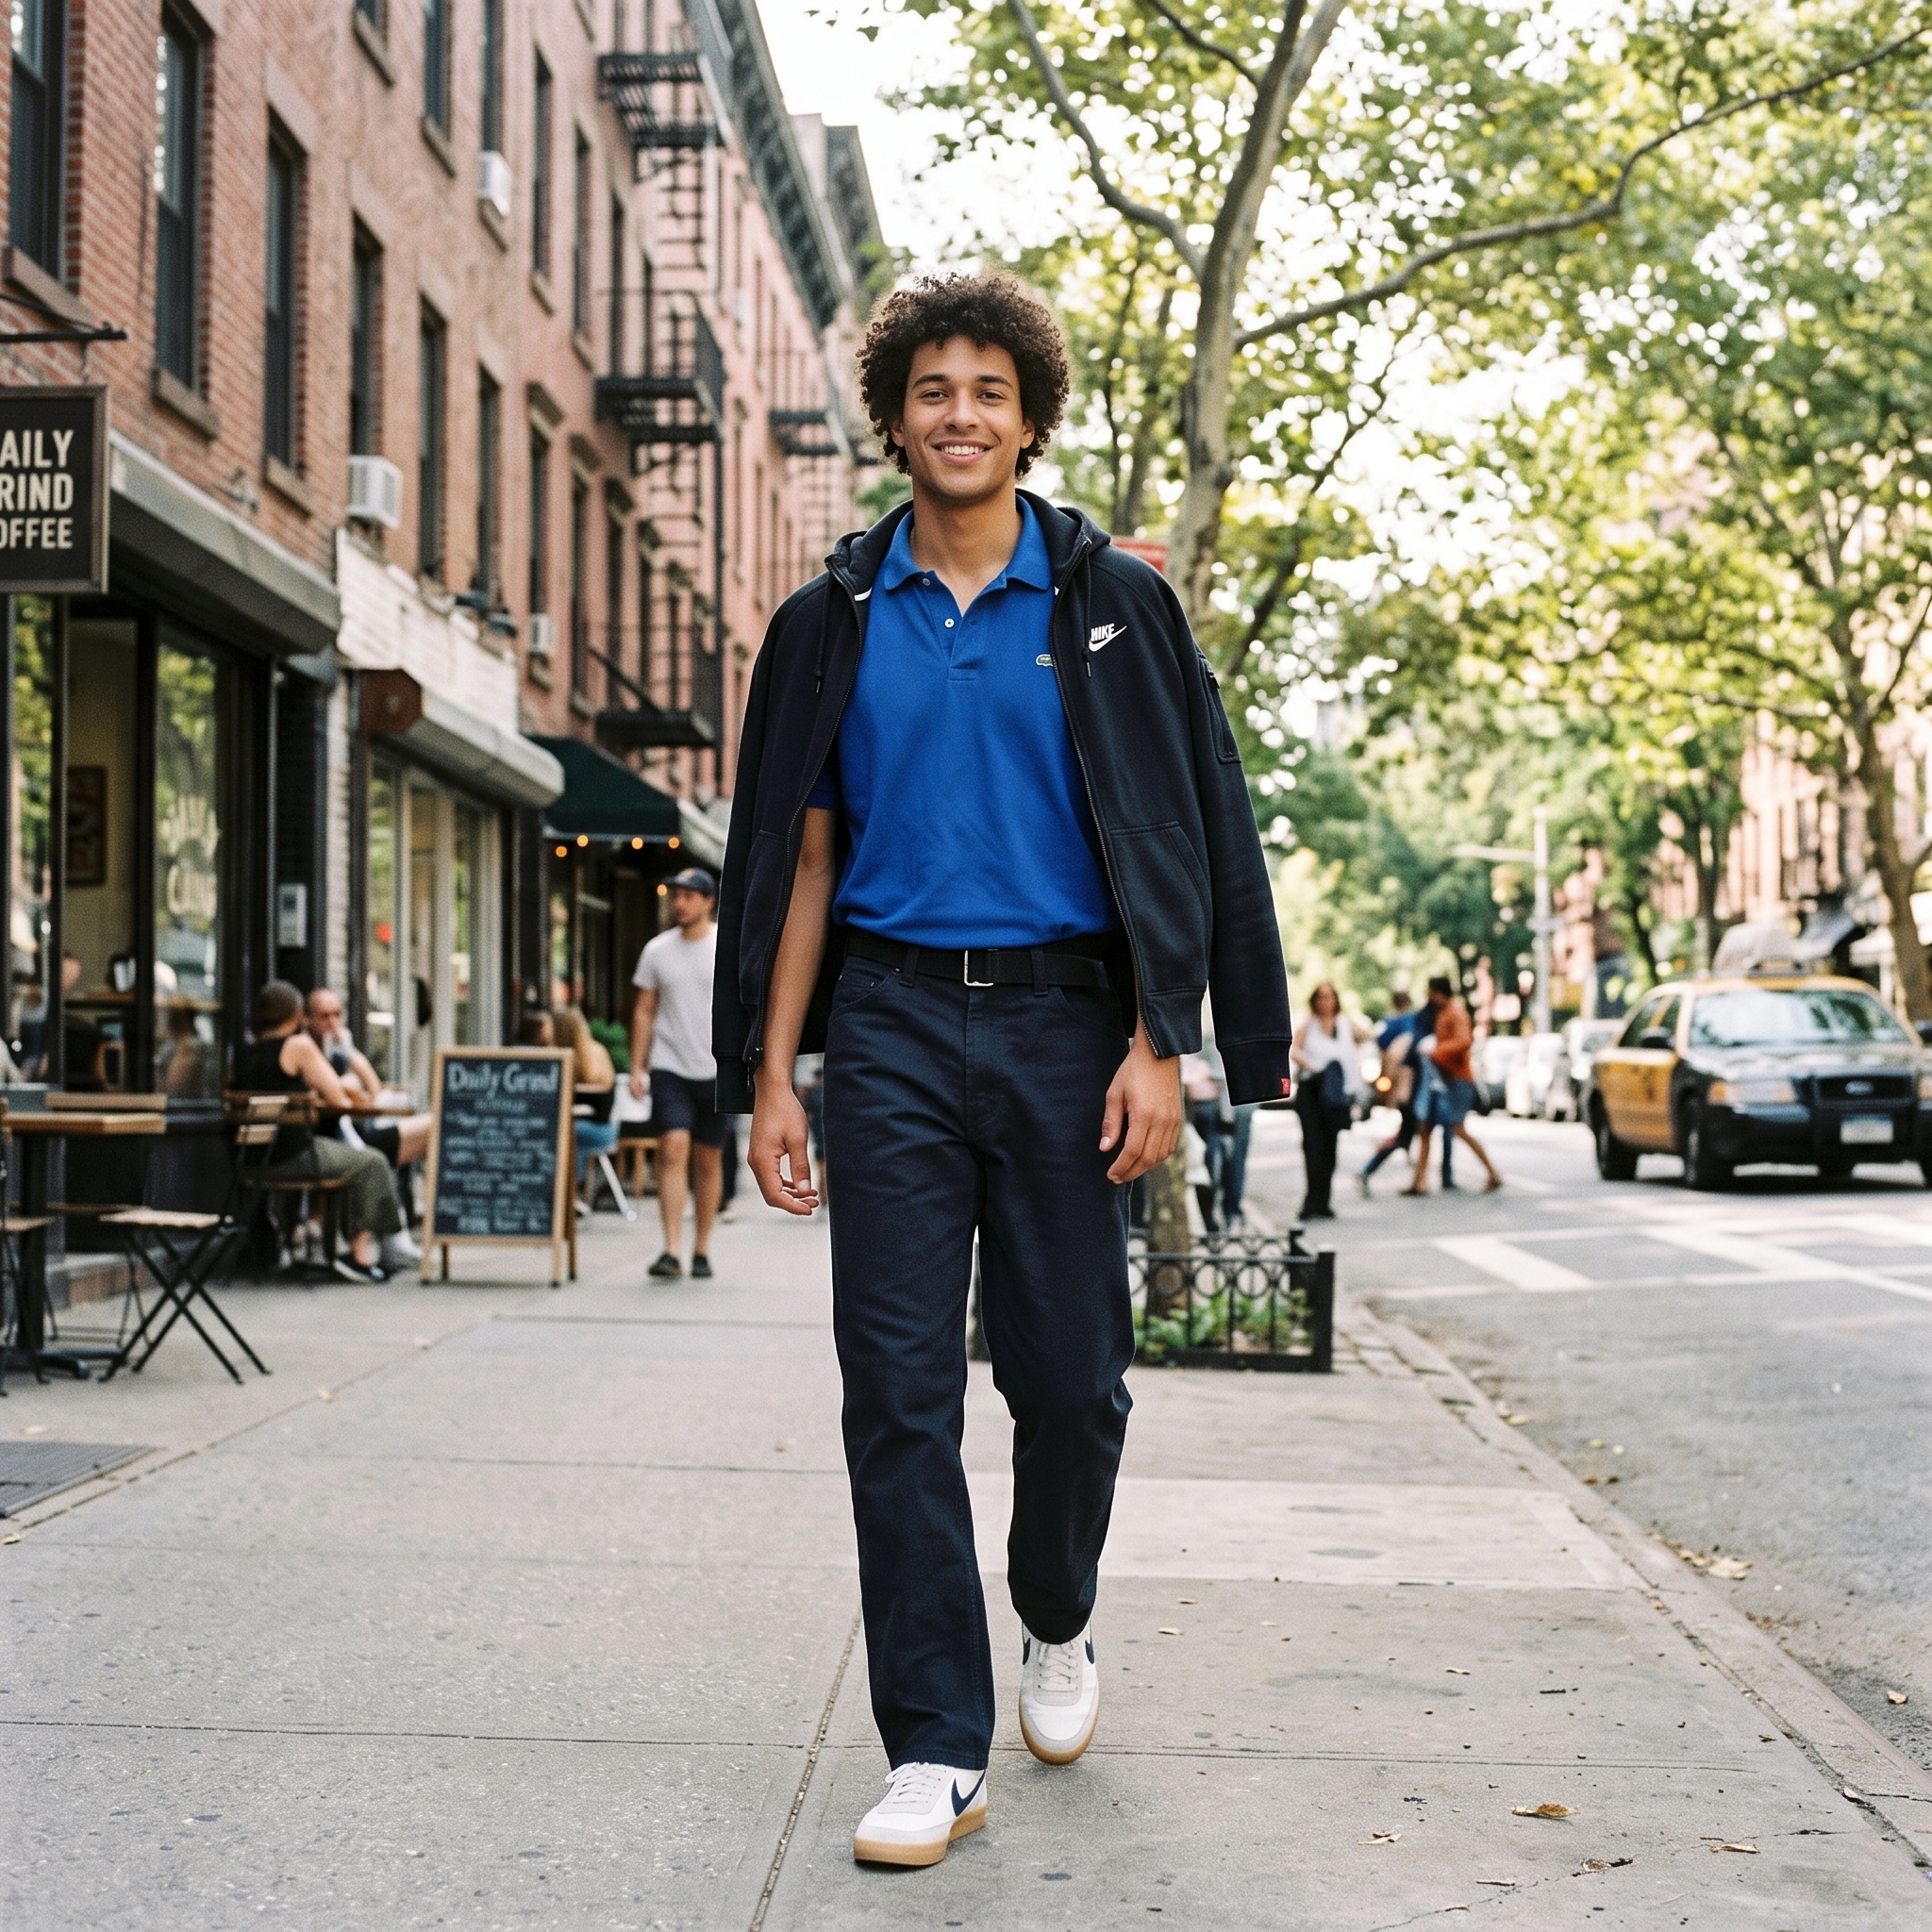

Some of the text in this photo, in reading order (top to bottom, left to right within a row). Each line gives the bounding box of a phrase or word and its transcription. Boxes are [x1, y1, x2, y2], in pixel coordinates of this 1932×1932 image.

[0, 429, 74, 468] AILY
[0, 473, 74, 511] RIND
[1091, 623, 1115, 641] NIKE
